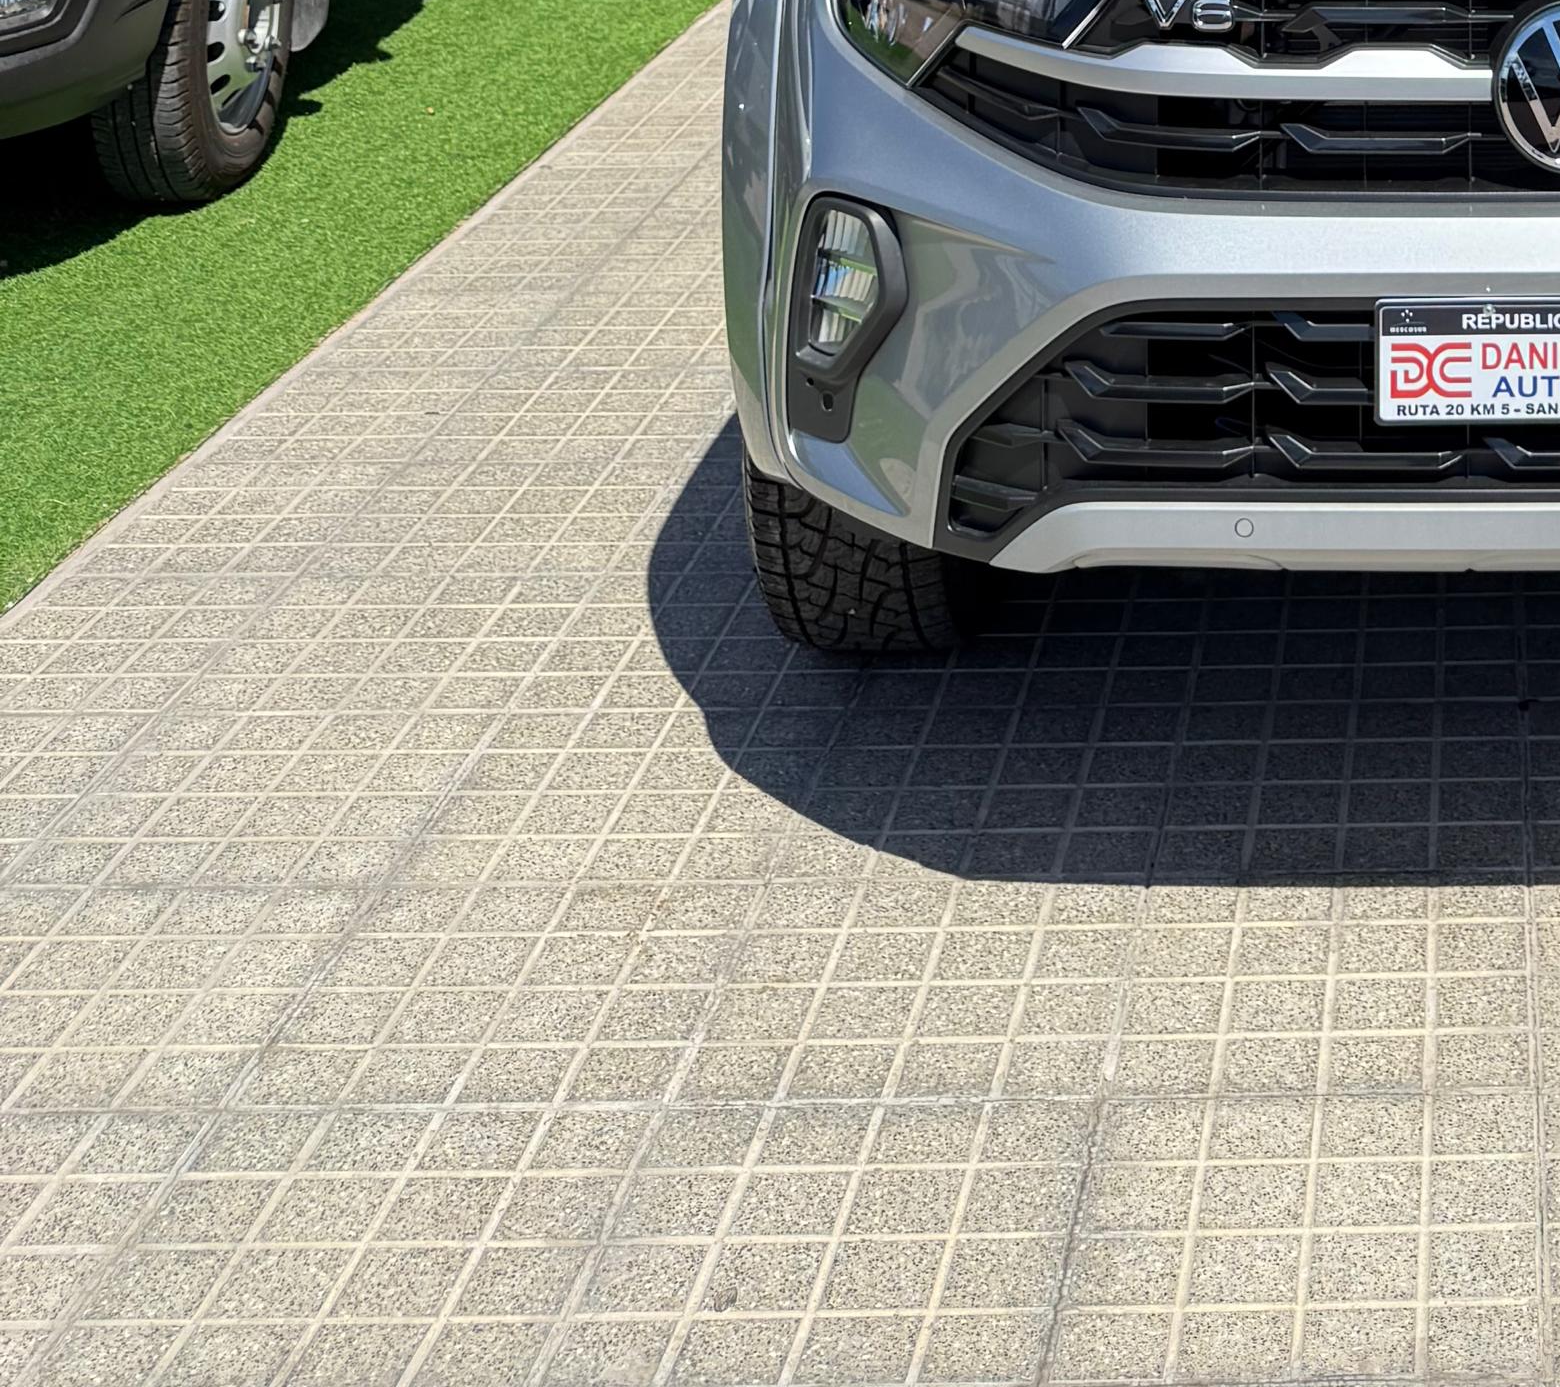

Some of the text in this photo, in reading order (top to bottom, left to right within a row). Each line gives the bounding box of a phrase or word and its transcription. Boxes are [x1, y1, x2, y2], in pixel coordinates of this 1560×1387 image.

[1397, 404, 1440, 416] RUTA
[1445, 404, 1464, 415] 20
[1470, 403, 1495, 415] KM
[1501, 403, 1510, 415] 5
[1525, 403, 1558, 414] SAN
